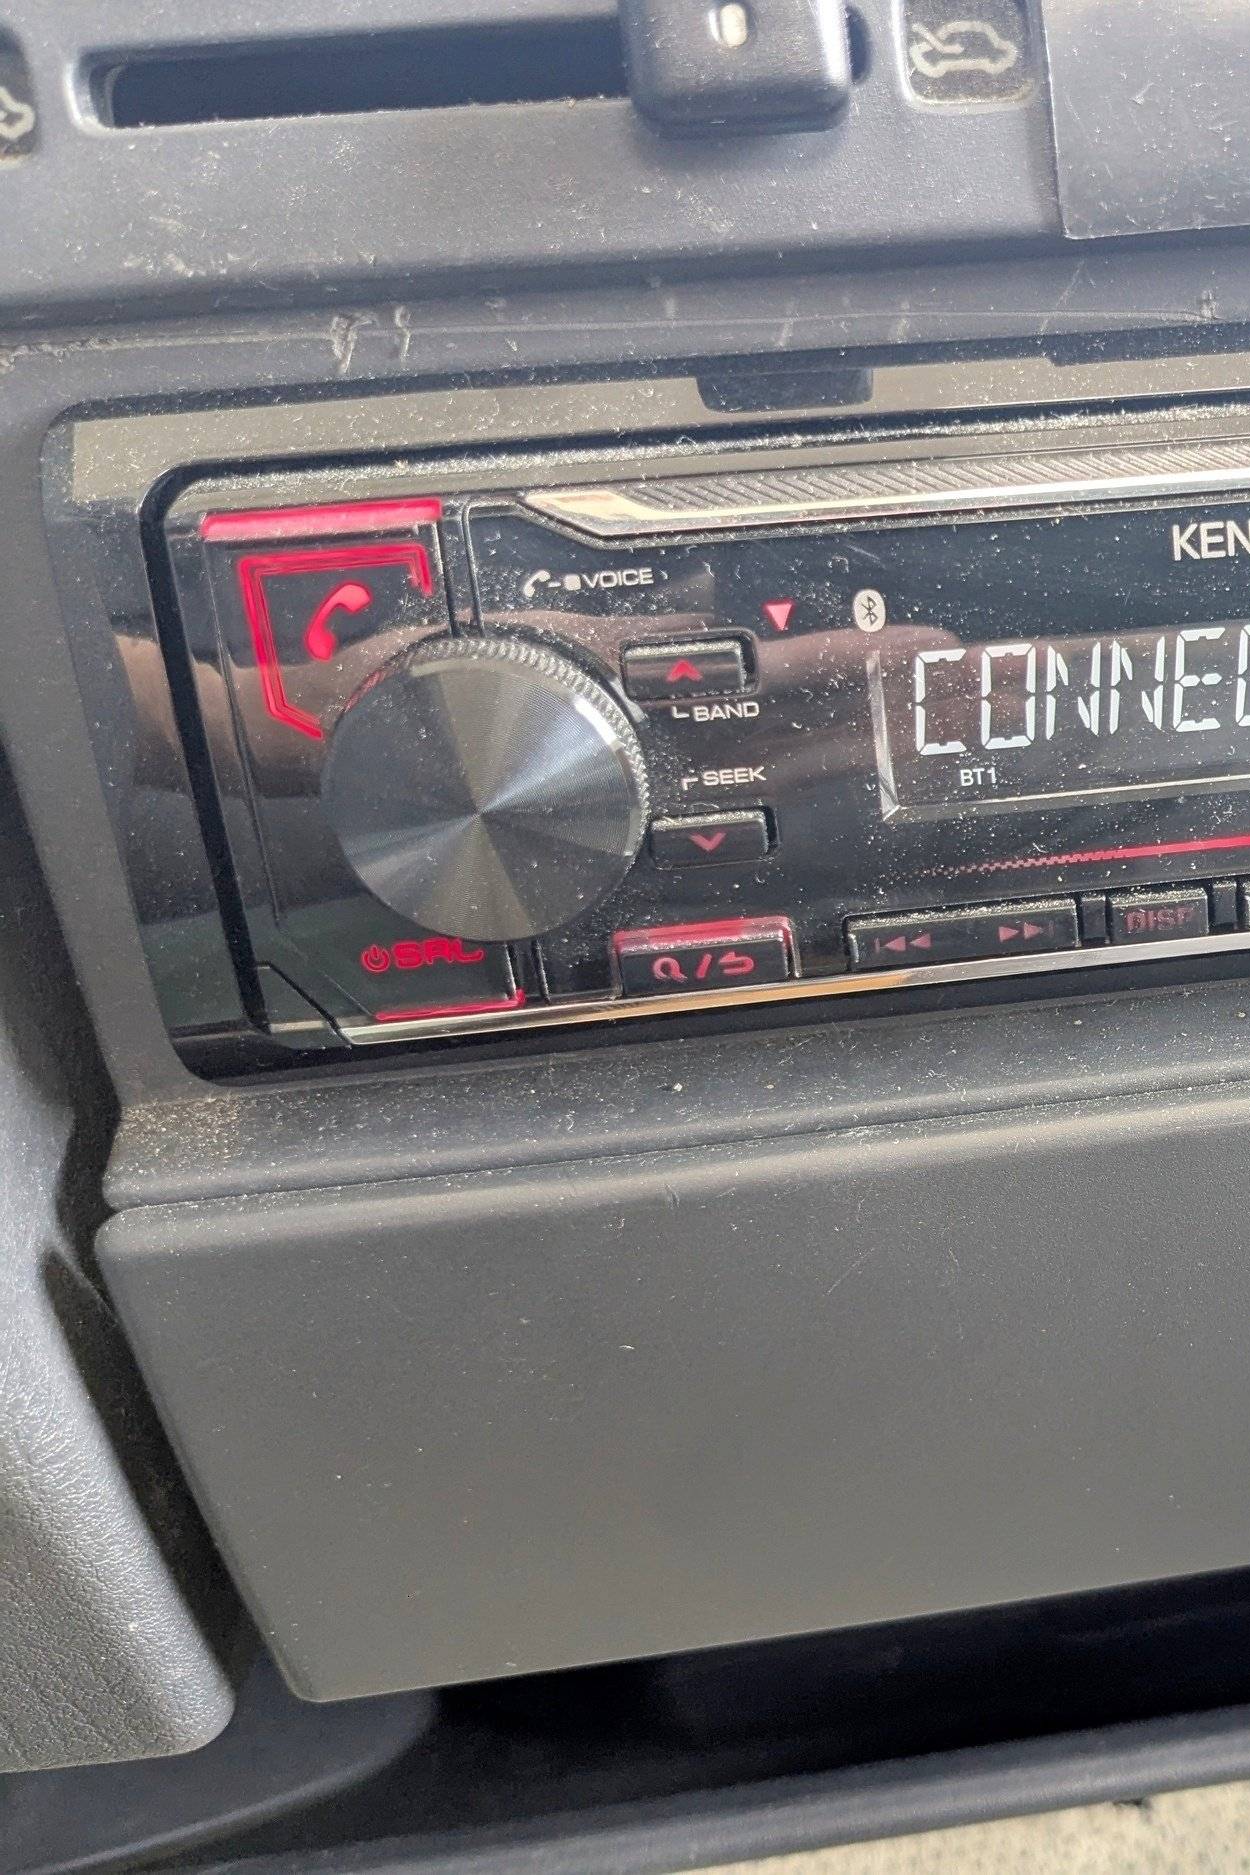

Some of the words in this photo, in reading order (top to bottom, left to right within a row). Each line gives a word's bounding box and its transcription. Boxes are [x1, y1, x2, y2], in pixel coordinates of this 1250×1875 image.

[581, 566, 654, 589] VOICE
[693, 701, 760, 722] BAND
[703, 765, 767, 787] SEEK
[960, 767, 996, 787] BT1
[1125, 906, 1195, 933] DISP
